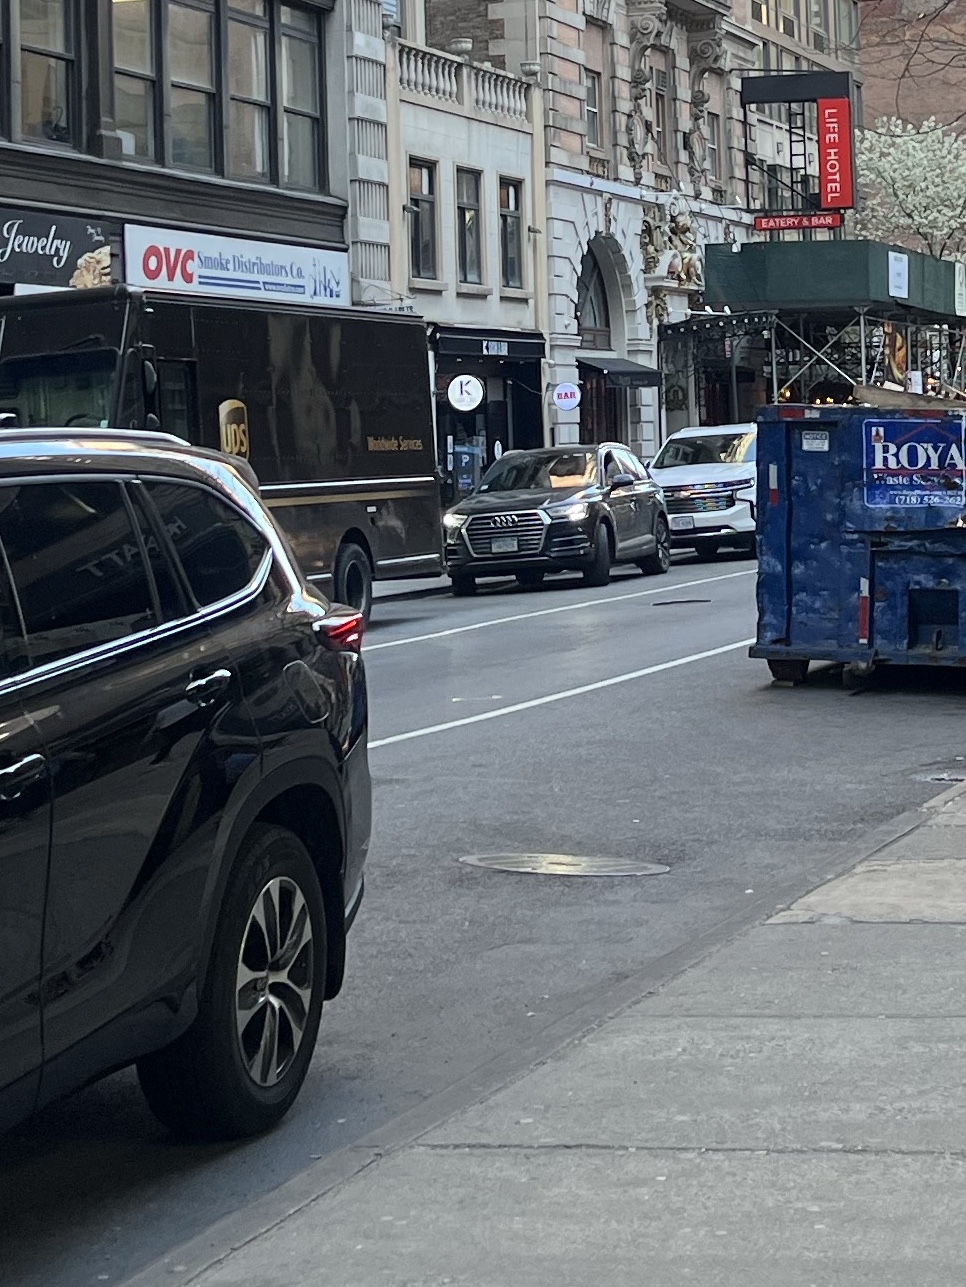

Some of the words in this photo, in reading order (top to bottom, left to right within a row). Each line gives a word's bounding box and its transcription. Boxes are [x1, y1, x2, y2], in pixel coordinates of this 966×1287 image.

[825, 108, 839, 144] LIFE
[826, 148, 841, 203] HOTEL
[761, 217, 800, 228] EATERY
[801, 217, 809, 226] &
[811, 216, 833, 227] BAR
[0, 219, 71, 269] Jewelry
[142, 244, 195, 284] OVC
[197, 251, 231, 272] Smoke
[232, 254, 289, 278] Distributors
[290, 261, 305, 280] Co.
[556, 391, 577, 400] BAR
[223, 423, 248, 455] ups
[366, 436, 398, 451] Worldwide
[399, 436, 423, 451] Services
[895, 496, 920, 505] (718)
[923, 495, 965, 505] 526-262
